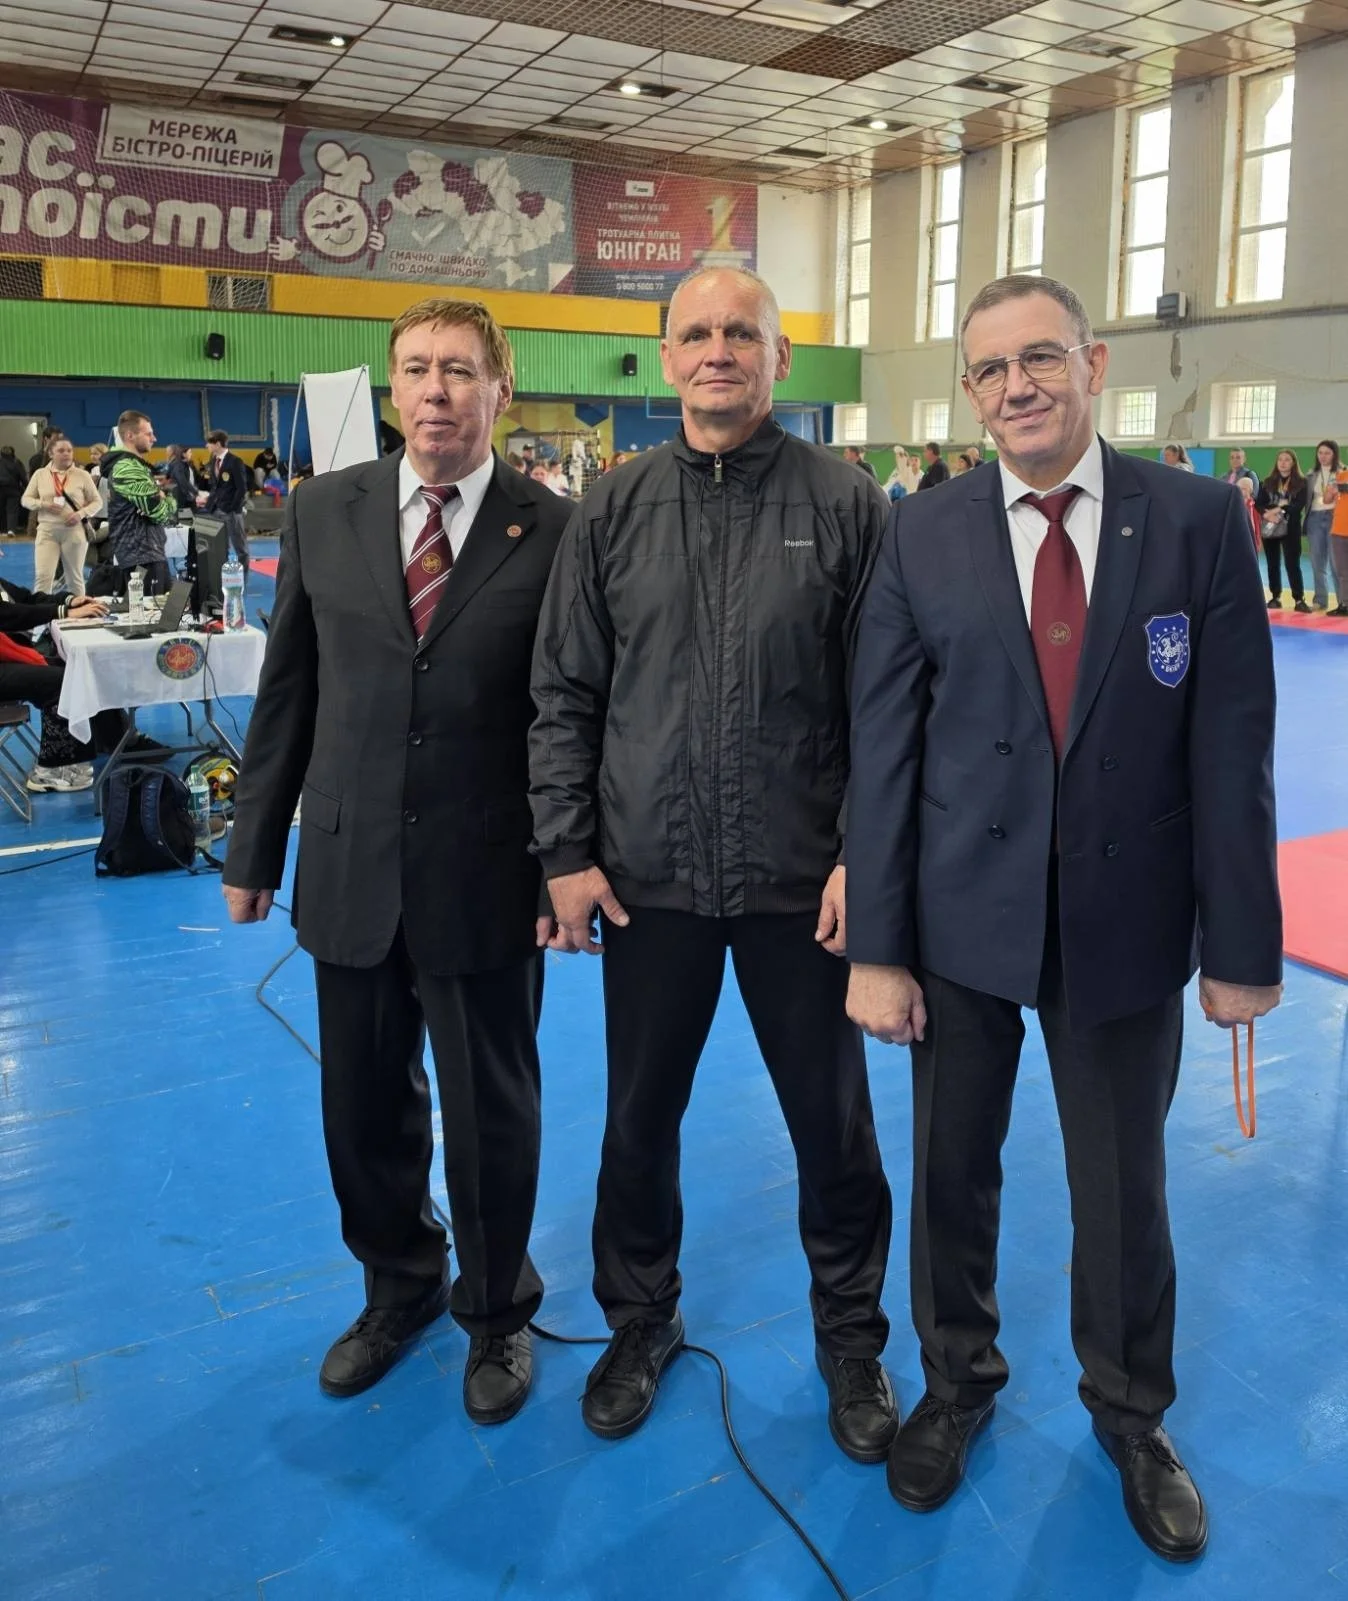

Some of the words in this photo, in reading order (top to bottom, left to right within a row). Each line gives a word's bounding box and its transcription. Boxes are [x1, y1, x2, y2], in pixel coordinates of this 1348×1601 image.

[148, 119, 238, 145] МЕРЕЖА
[112, 136, 274, 169] БІСТРО-ПІЦЕРІЙ
[597, 241, 682, 261] ЮНІГРАН
[784, 539, 814, 547] Reebok
